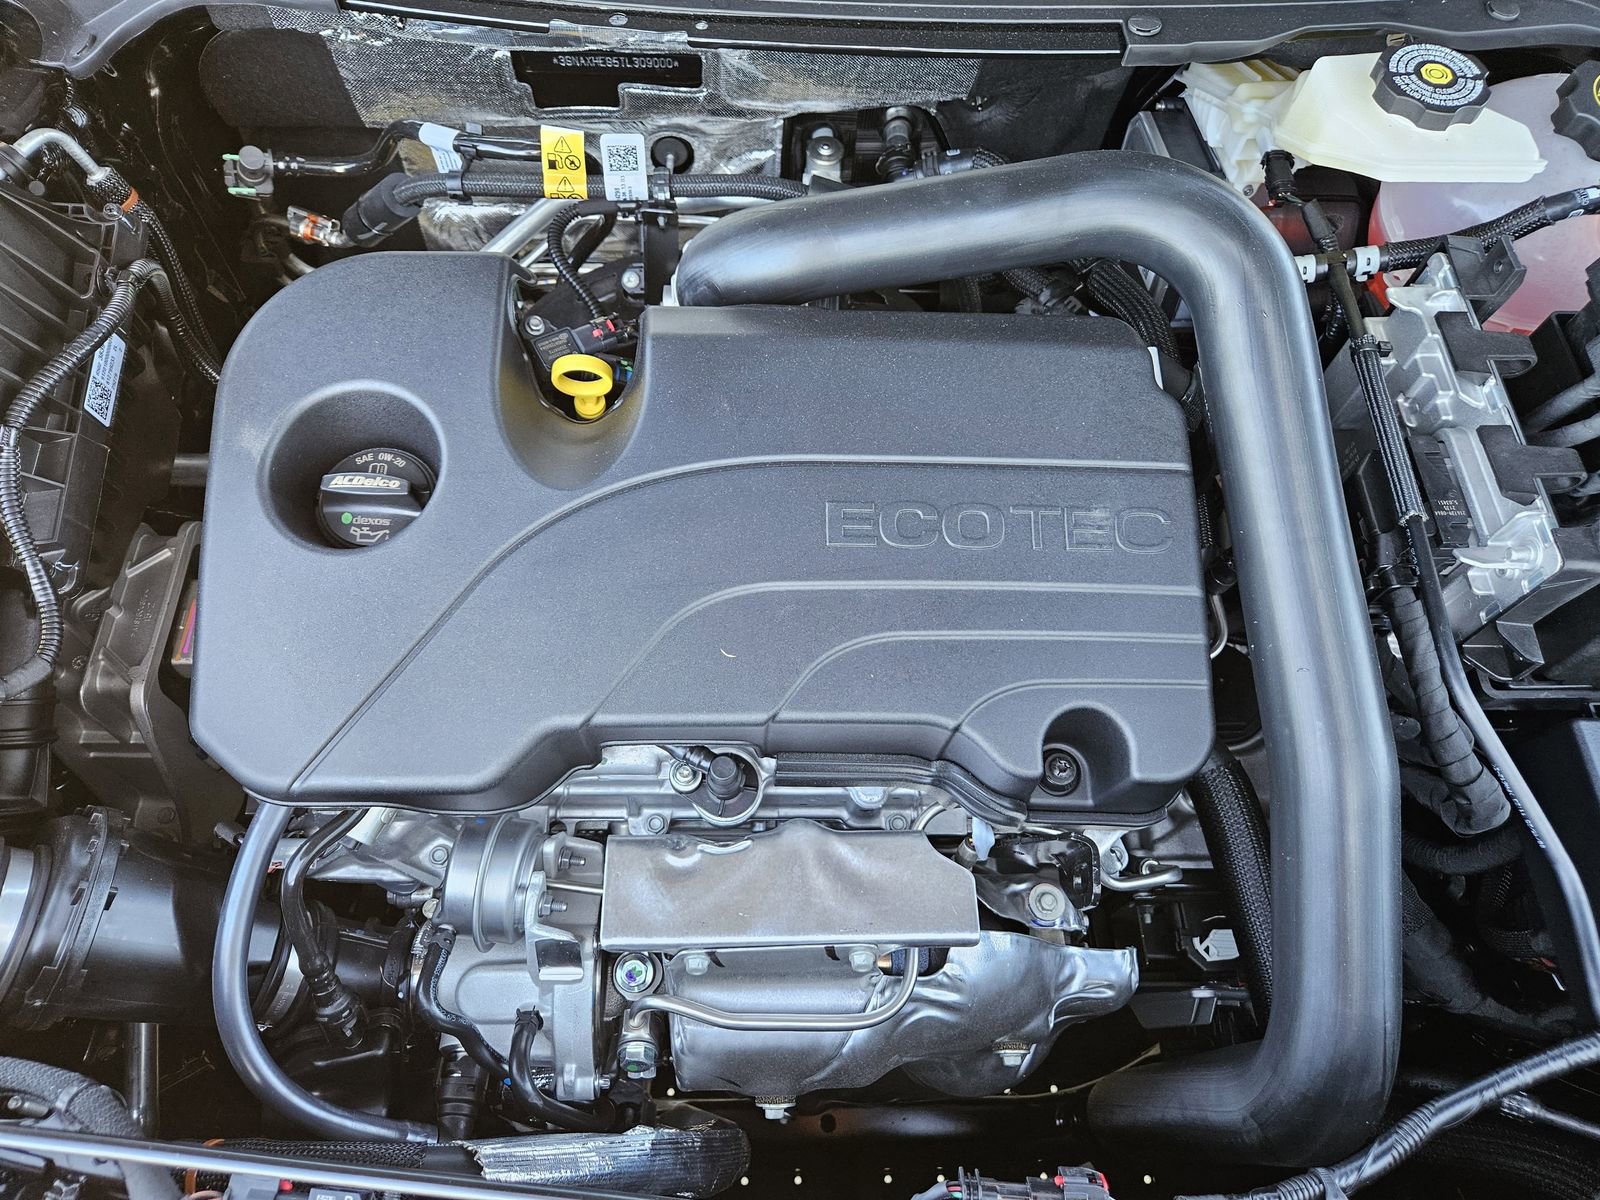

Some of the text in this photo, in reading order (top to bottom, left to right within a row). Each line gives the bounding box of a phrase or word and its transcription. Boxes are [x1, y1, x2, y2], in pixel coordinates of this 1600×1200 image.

[355, 452, 407, 468] SAE 0W-20
[330, 475, 401, 488] ACDelco
[352, 515, 391, 526] dexos
[825, 500, 1174, 554] ECOTEC
